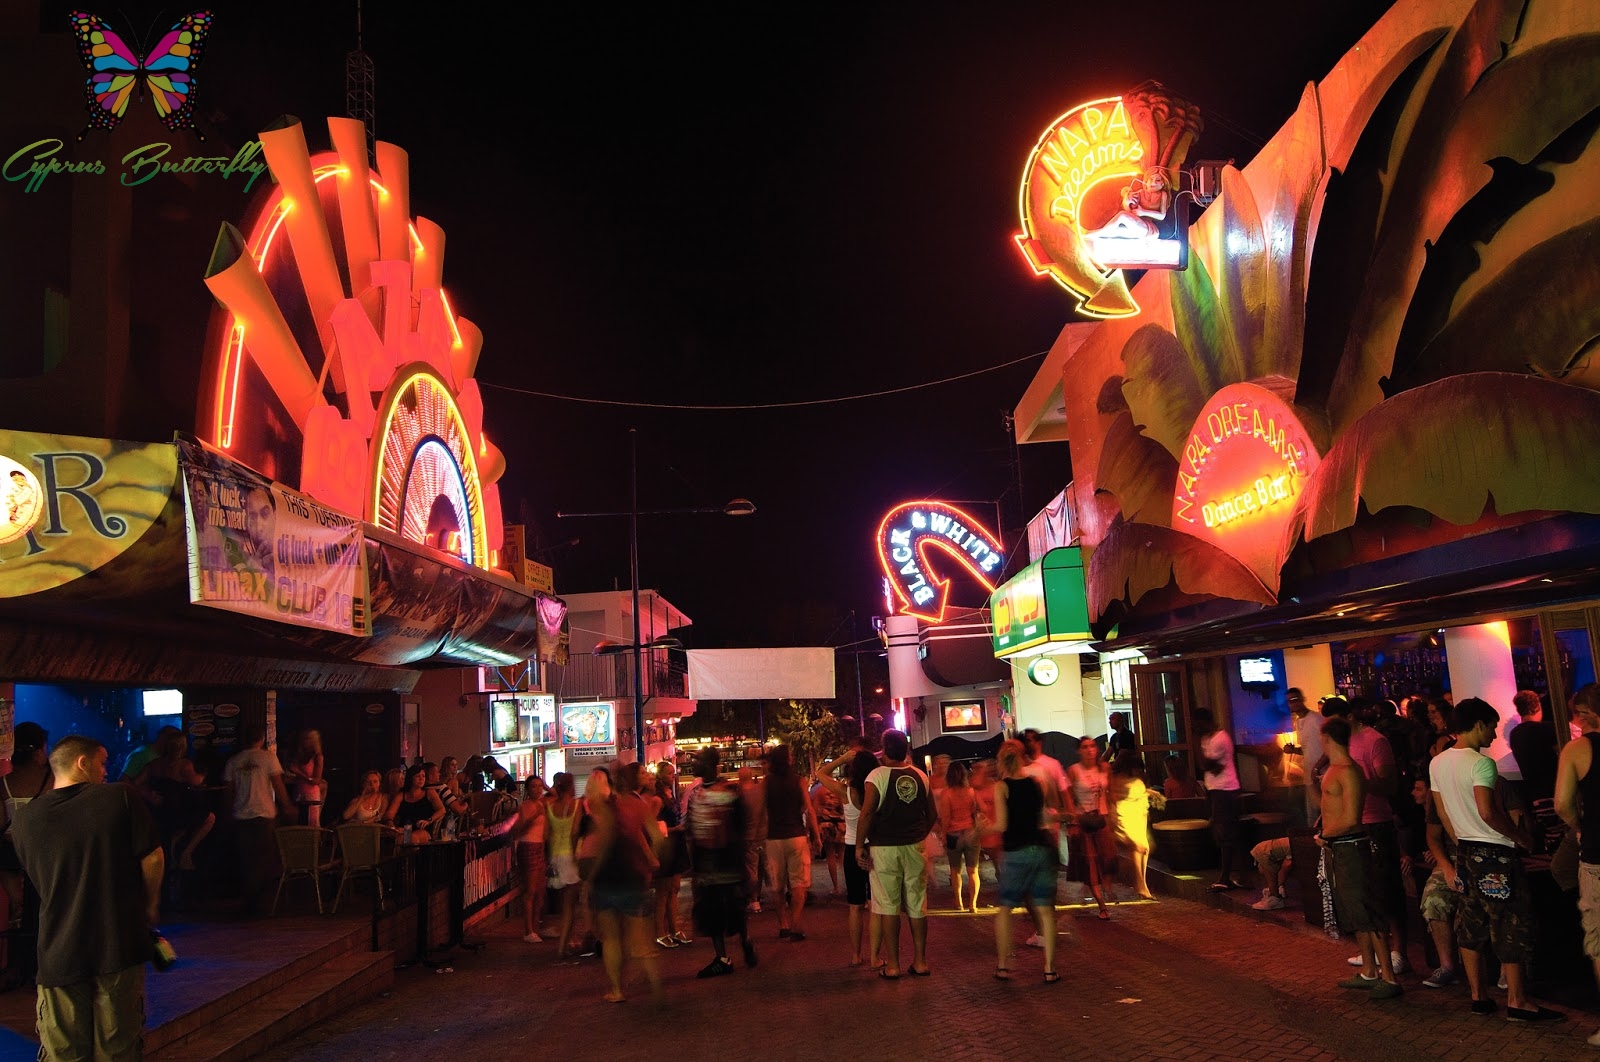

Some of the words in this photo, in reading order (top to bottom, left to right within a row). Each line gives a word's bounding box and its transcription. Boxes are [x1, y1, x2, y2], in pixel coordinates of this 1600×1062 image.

[1040, 101, 1130, 182] NAPA
[1051, 140, 1144, 224] Dreams
[1175, 434, 1212, 523] NAPA
[1207, 402, 1301, 477] DREAMS
[208, 505, 226, 526] mc
[219, 483, 241, 508] luck
[281, 490, 309, 520] THIS
[911, 511, 927, 529] &
[1201, 489, 1257, 528] Dance
[1254, 475, 1287, 506] Bar
[277, 533, 289, 569] dj
[290, 535, 315, 566] luck
[323, 542, 341, 565] mc
[891, 528, 935, 606] BLACK
[930, 512, 1001, 572] WHITE
[276, 576, 327, 622] CLUB
[334, 591, 366, 630] ICE
[519, 698, 540, 712] HOURS
